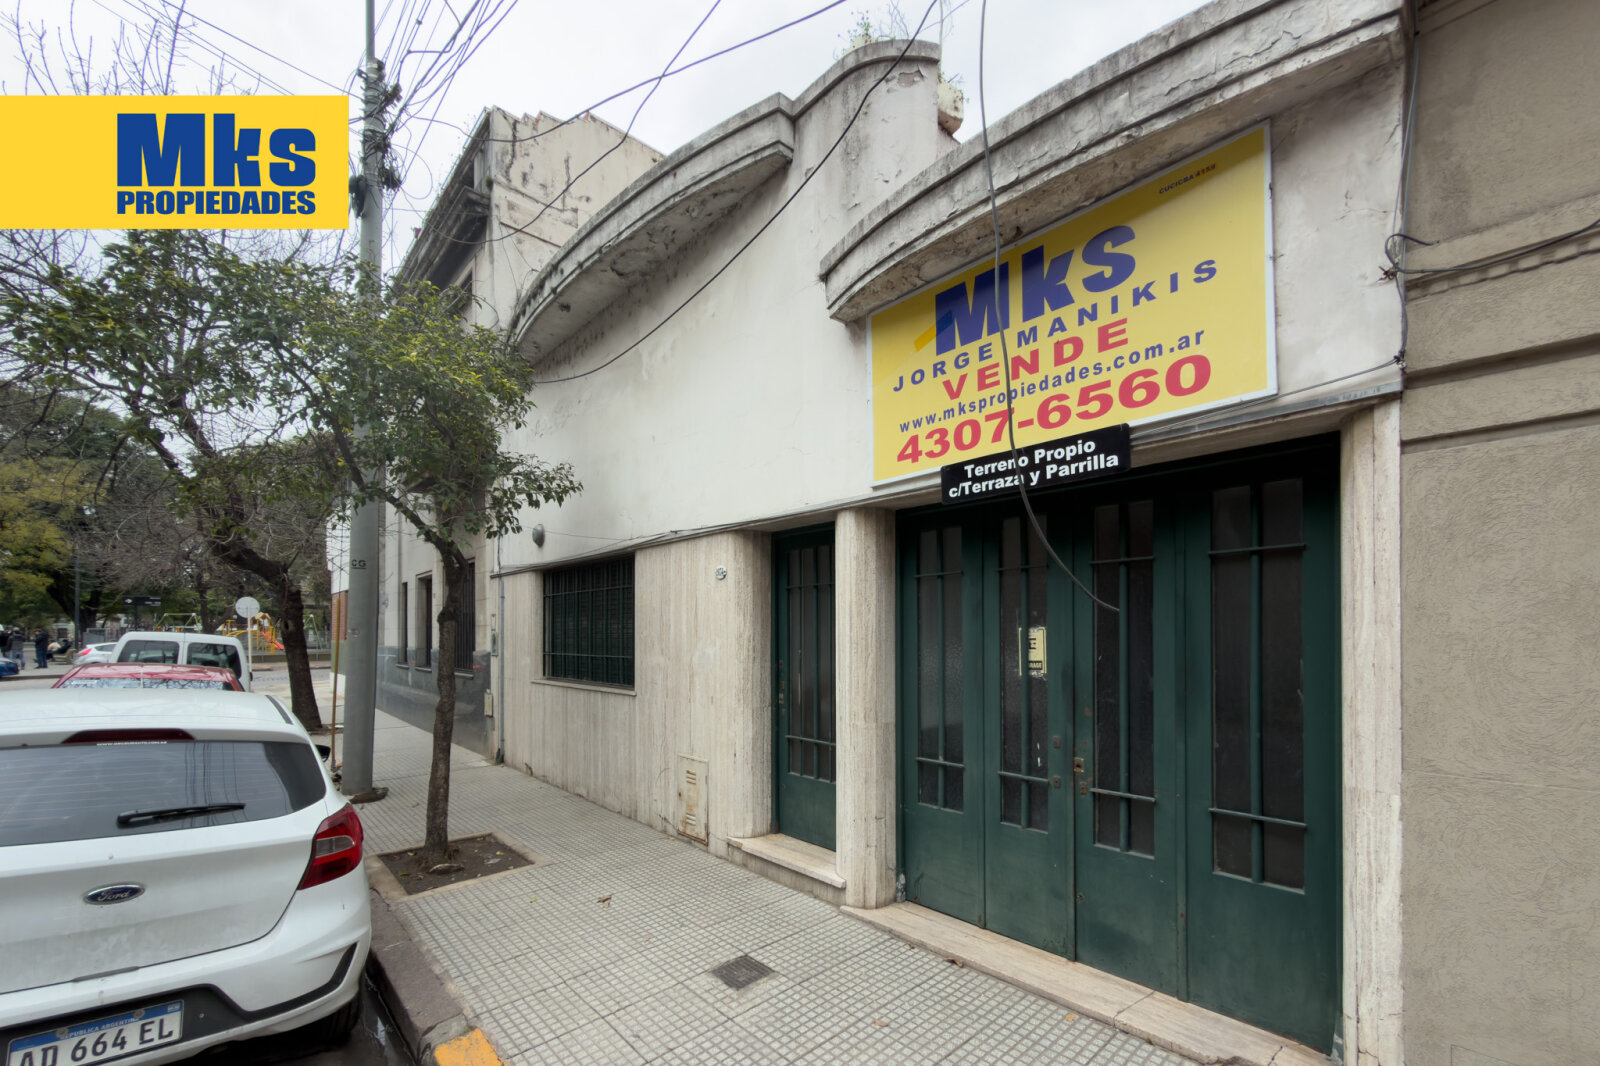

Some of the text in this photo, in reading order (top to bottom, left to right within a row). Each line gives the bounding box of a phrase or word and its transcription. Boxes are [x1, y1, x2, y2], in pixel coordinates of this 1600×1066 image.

[893, 259, 1217, 392] JORGE MANIKIS
[942, 317, 1129, 401] VENDE
[896, 354, 1212, 464] 4307-6560
[899, 329, 1205, 433] www.mkspropiedades.com.ar
[948, 453, 1119, 498] c/Terraza y Parrilla
[964, 439, 1096, 478] Terreno Propio
[20, 1018, 174, 1066] AD 664 EL
